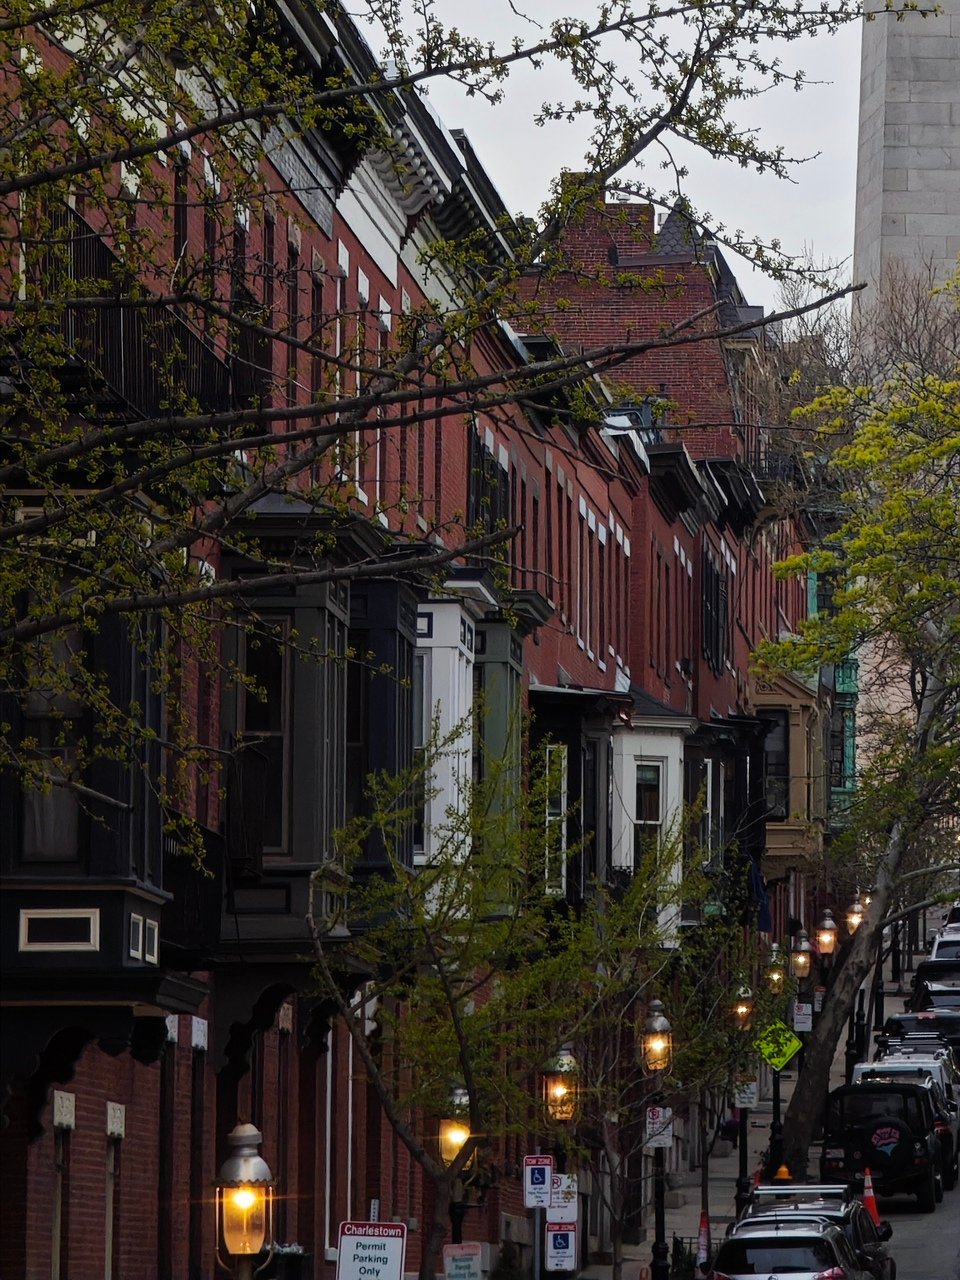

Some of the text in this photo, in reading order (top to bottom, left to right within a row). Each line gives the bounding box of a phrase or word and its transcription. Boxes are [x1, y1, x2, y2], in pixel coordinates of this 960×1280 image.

[344, 1224, 402, 1237] Charlestown
[355, 1241, 386, 1251] Permit
[352, 1254, 388, 1265] Parking
[358, 1266, 381, 1277] Only
